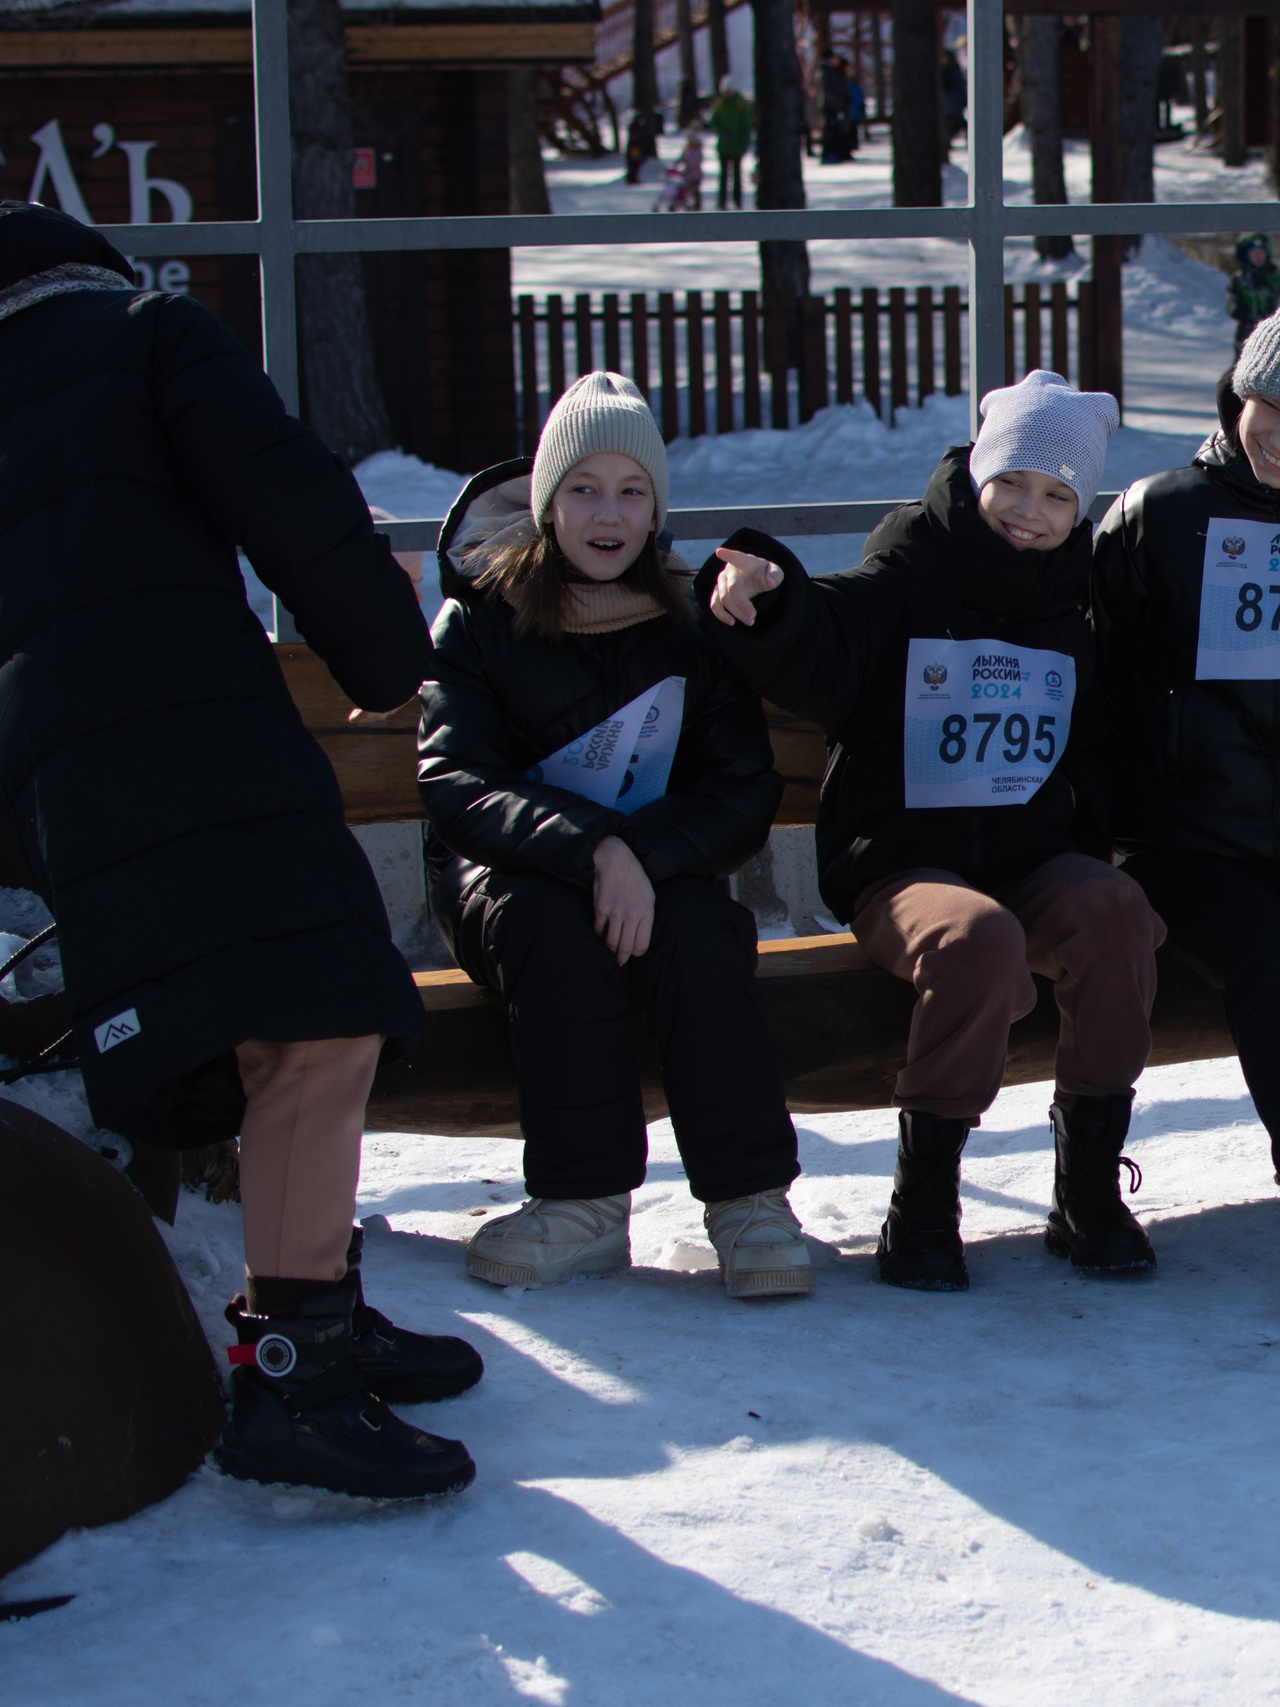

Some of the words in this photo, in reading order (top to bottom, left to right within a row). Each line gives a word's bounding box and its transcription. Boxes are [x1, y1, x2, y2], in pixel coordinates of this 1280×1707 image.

[972, 655, 1020, 669] ЛЫЖНЯ
[972, 668, 1022, 681] РОССИИ
[970, 683, 1022, 700] 2024
[939, 713, 1056, 764] 8795
[992, 776, 1043, 784] ЧЕЛЯБИНСКАЯ
[991, 784, 1027, 793] ОБЛАСТЬ
